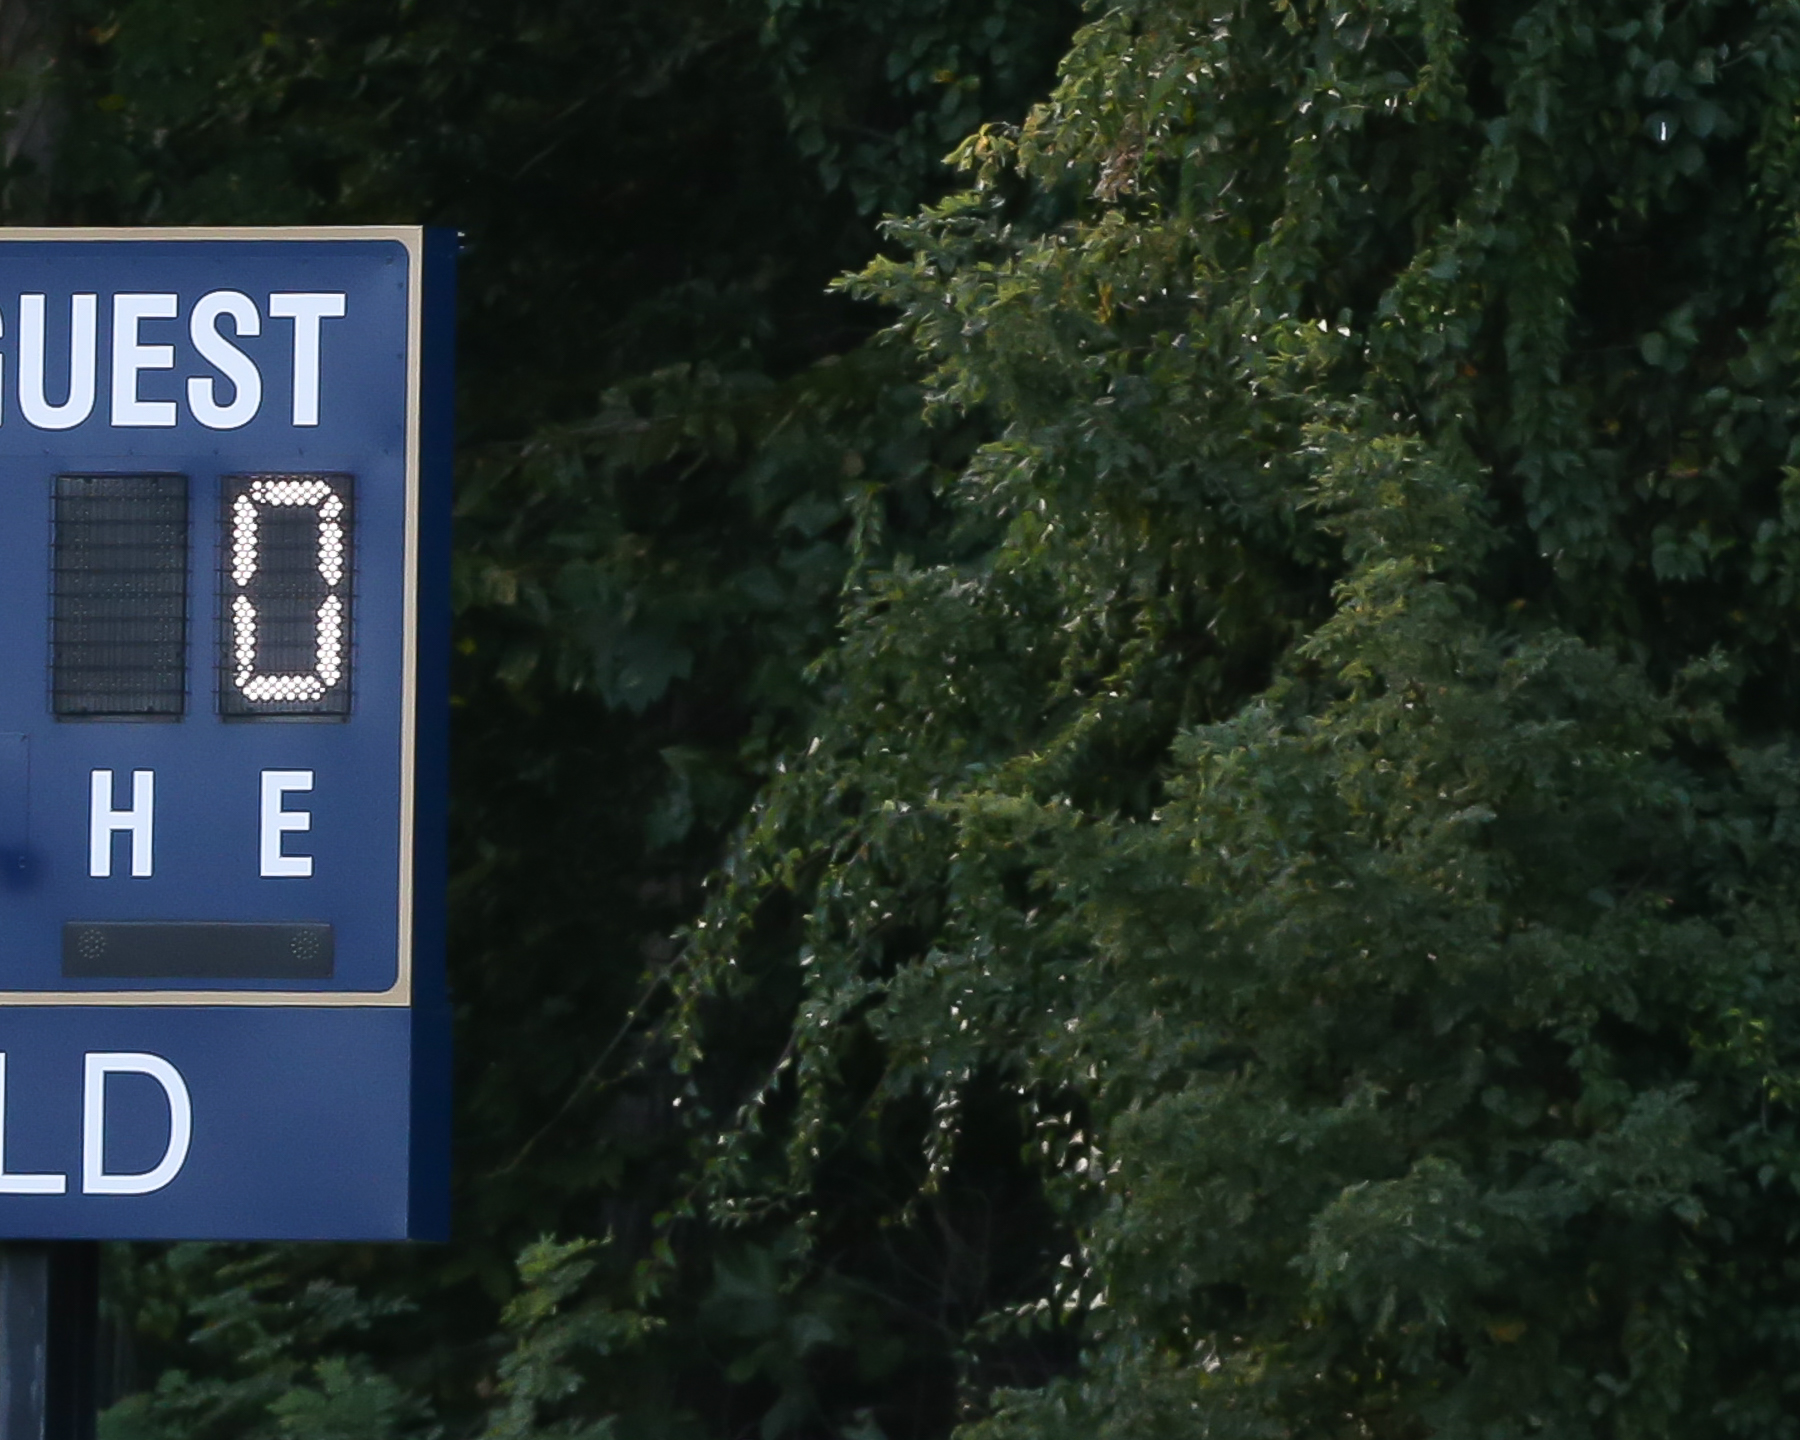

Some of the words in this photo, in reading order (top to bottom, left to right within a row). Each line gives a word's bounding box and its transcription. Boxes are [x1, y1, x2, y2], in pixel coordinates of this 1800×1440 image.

[231, 479, 345, 702] 0
[89, 769, 155, 878] H
[259, 769, 314, 878] E
